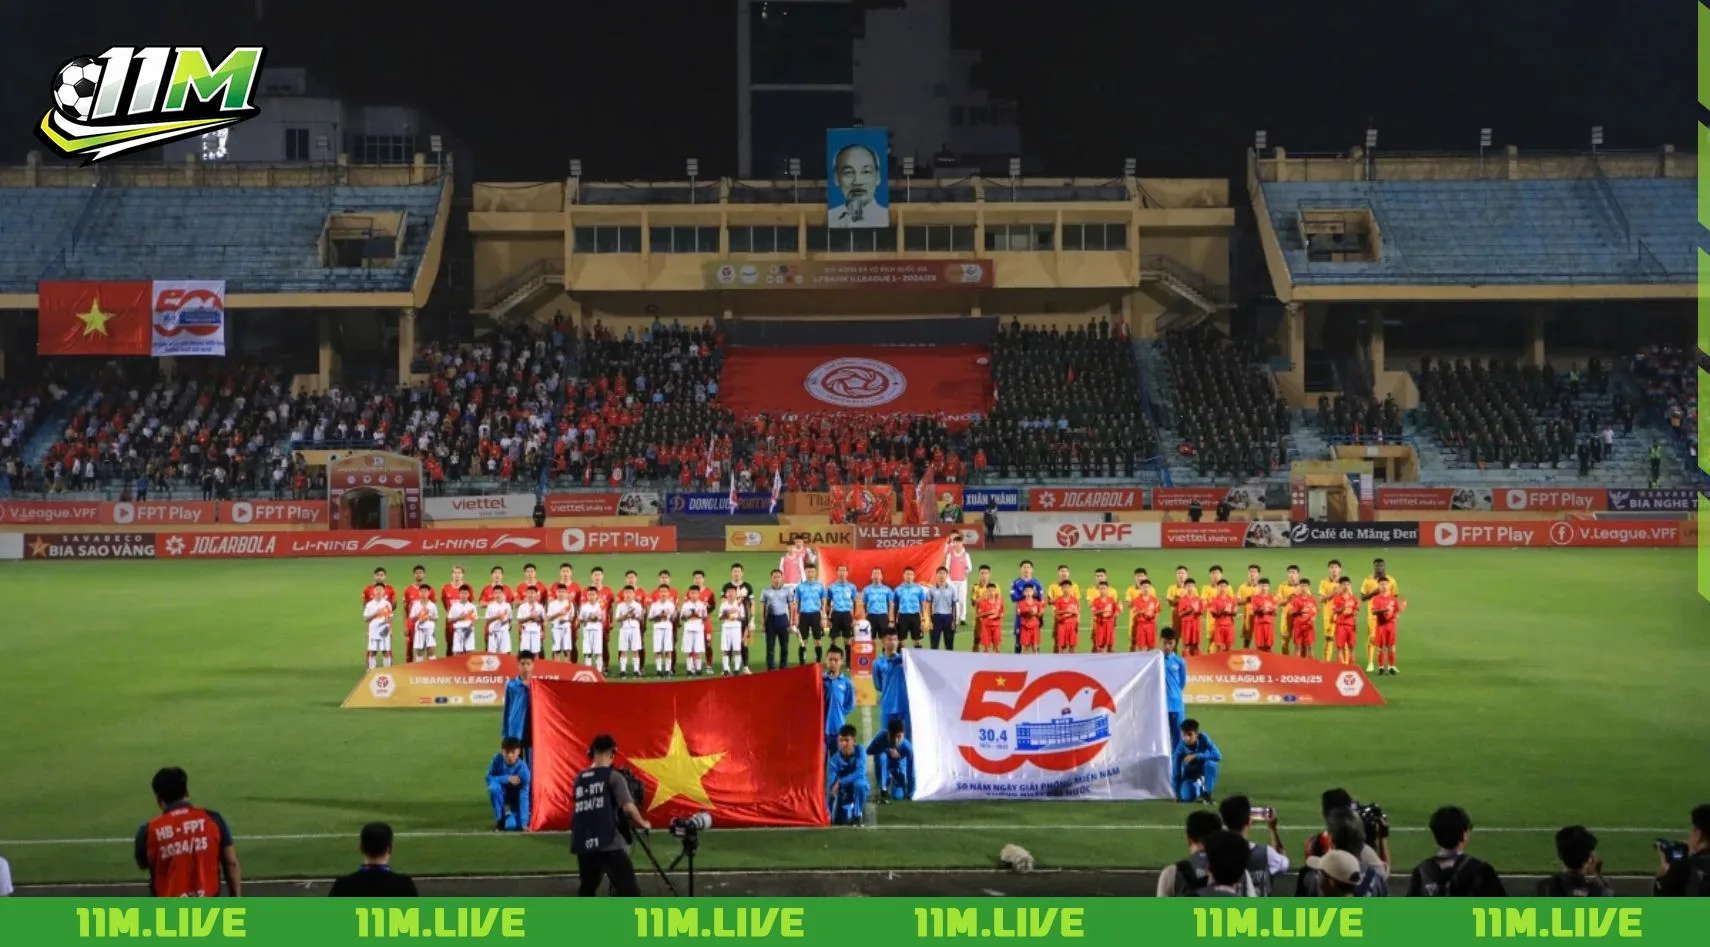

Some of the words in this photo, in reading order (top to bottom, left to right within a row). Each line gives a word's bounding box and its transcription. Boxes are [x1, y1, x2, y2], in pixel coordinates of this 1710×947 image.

[452, 497, 507, 510] viettel
[1060, 491, 1134, 507] JOGARBOLA
[1530, 492, 1560, 506] FPT
[1562, 492, 1594, 509] Play
[1629, 500, 1651, 508] BIA
[10, 507, 97, 520] V.League.VPF
[137, 501, 168, 518] FPT
[170, 501, 202, 522] Play
[256, 501, 287, 518] FPT
[289, 501, 320, 521] Play
[858, 526, 930, 538] V.LEAGUE
[934, 526, 941, 537] 1
[1082, 524, 1132, 541] VPF
[1311, 527, 1336, 539] Café
[1339, 527, 1354, 539] de
[1461, 527, 1494, 541] FPT
[1496, 527, 1533, 545] Play
[1580, 527, 1677, 543] V.League.VPF
[189, 535, 276, 554] JOGARBOLA
[292, 539, 358, 551] LI-NING
[422, 538, 488, 550] LI-NING
[588, 532, 621, 547] FPT
[623, 532, 660, 550] Play
[49, 544, 74, 556] BIA
[78, 544, 109, 556] SAO
[112, 542, 155, 556] VÀNG
[454, 675, 505, 684] V.LEAGUE
[1215, 674, 1266, 683] V.LEAGUE
[1280, 674, 1323, 683] 2024/25
[978, 728, 1008, 741] 30.4
[155, 824, 174, 841] HB
[183, 818, 206, 834] FPT
[160, 837, 207, 858] 2024/25
